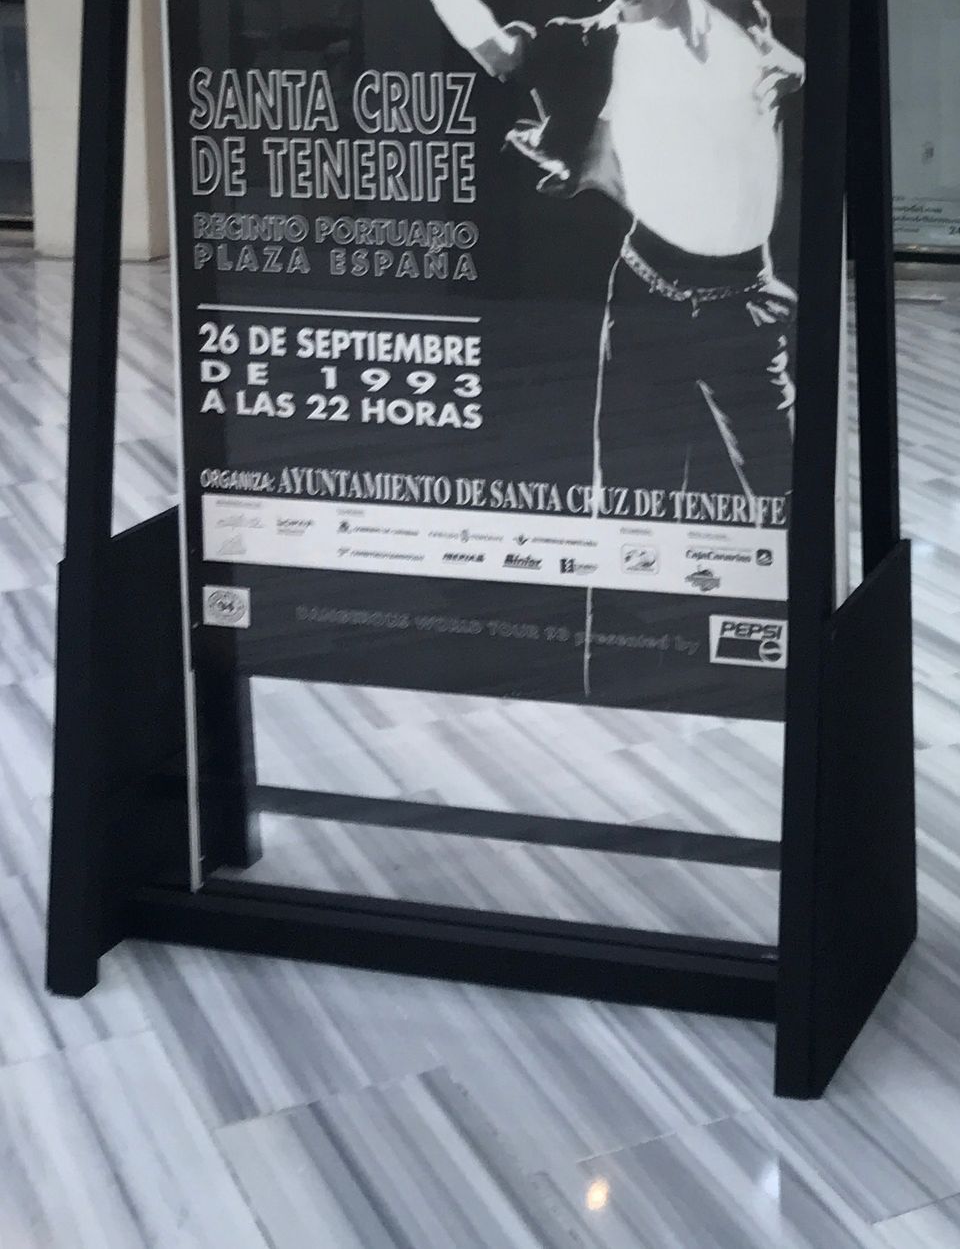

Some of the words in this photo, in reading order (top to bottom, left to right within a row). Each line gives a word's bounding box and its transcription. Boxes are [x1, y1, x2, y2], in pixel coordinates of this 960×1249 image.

[188, 66, 340, 132] SANTA
[352, 69, 478, 137] CRUZ
[191, 135, 248, 198] DE
[262, 137, 477, 204] TENERIFE
[193, 212, 310, 243] RECINTO
[315, 216, 480, 250] PORTUARIO
[193, 243, 311, 274] PLAZA
[330, 244, 479, 281] ESPAÑA
[199, 322, 240, 356] 26
[248, 324, 288, 357] DE
[296, 326, 482, 367] SEPTIEMBRE
[201, 388, 226, 414] A
[236, 390, 296, 419] LAS
[306, 393, 351, 422] 22
[361, 397, 484, 430] HORAS
[277, 466, 451, 506] AYUNTAMIENTO
[455, 479, 488, 508] DE
[490, 478, 563, 512] SANTA
[566, 484, 630, 517] CRUZ
[634, 488, 666, 519] DE
[669, 491, 787, 526] TENERIFE
[720, 621, 783, 641] PEPSI
